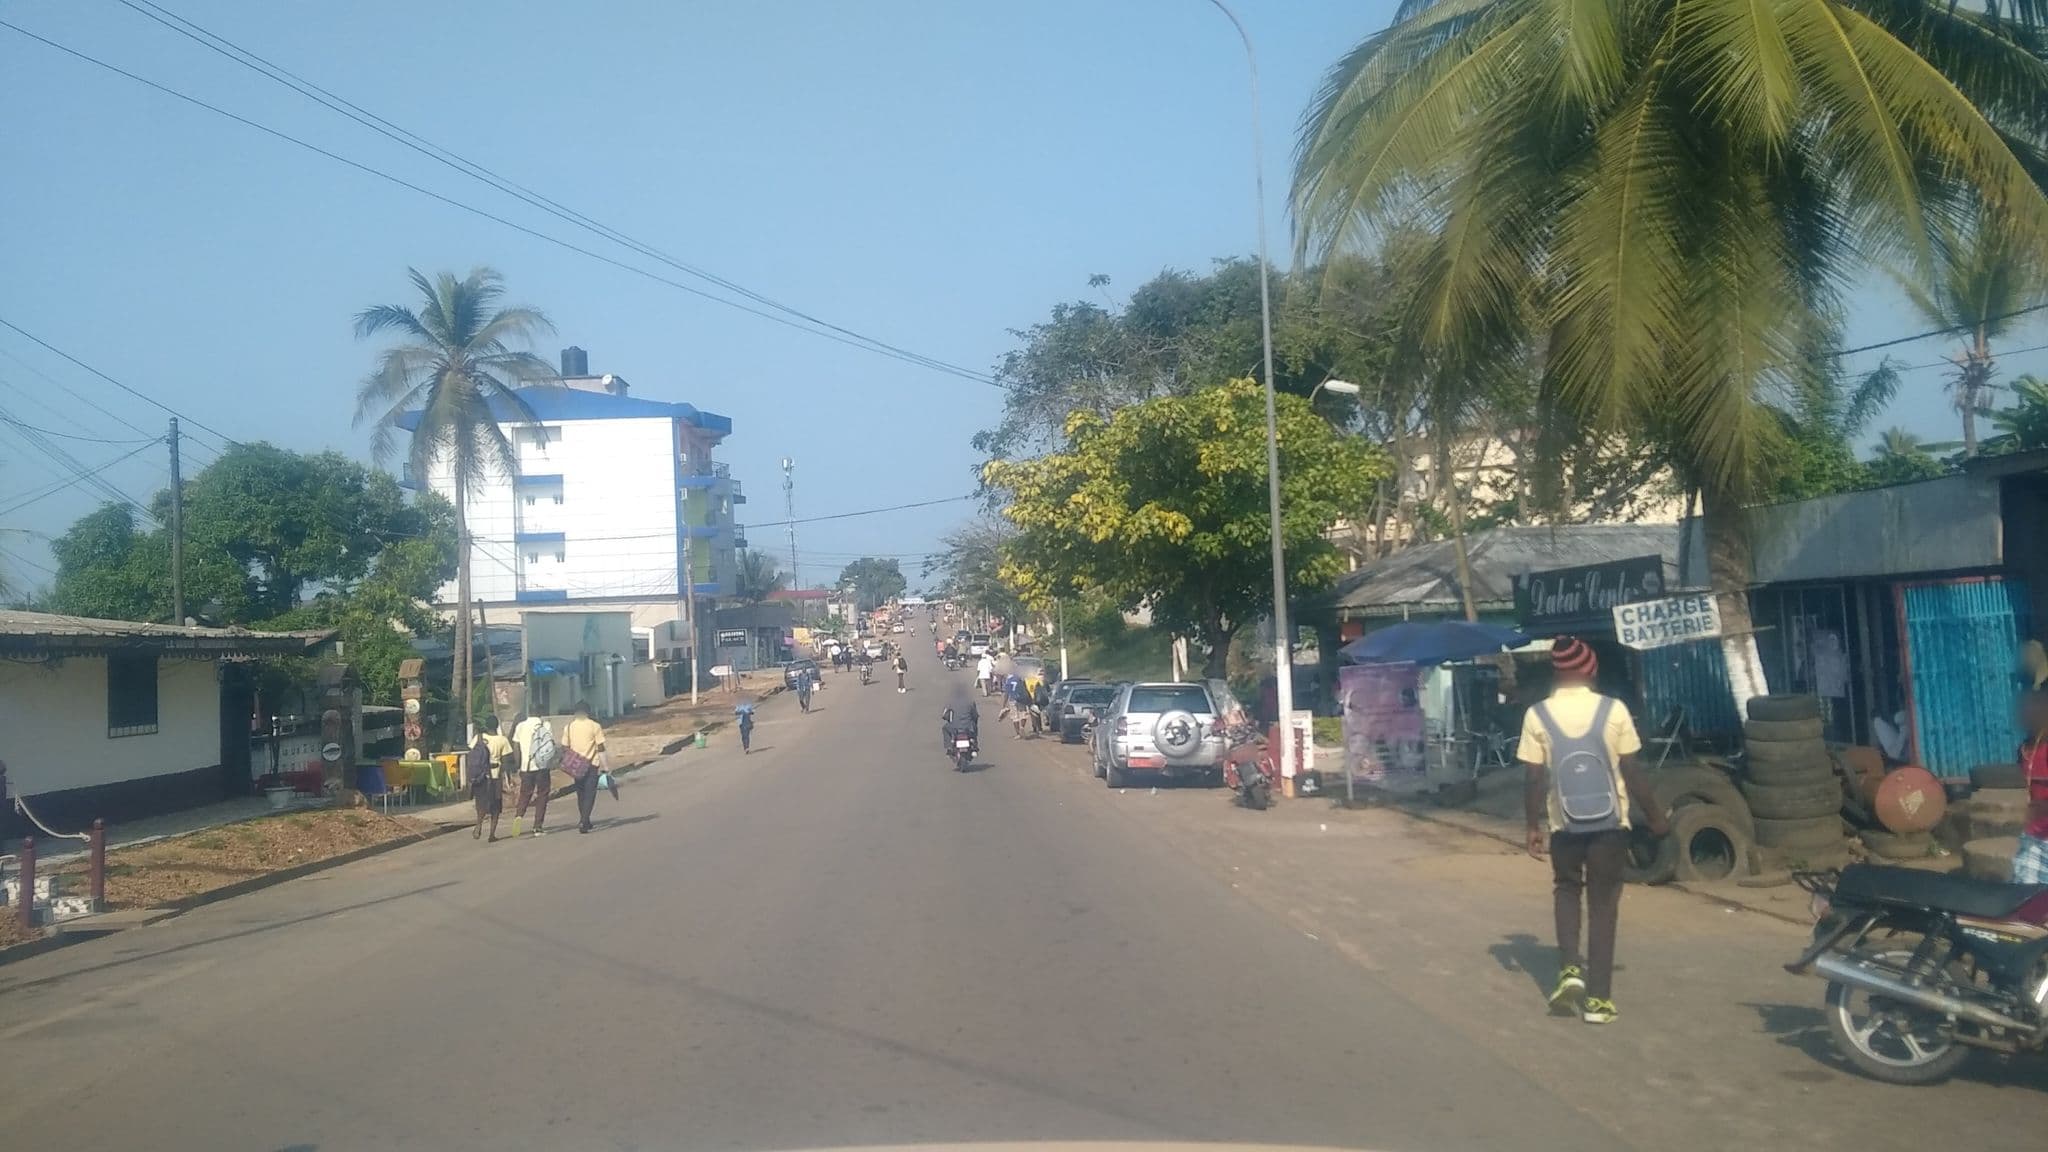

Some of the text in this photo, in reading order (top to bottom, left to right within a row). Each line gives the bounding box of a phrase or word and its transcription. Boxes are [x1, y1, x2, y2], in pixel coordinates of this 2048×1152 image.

[1622, 595, 1713, 626] CHARGE
[1622, 615, 1714, 643] BATTERIE
[1010, 681, 1018, 691] 7
